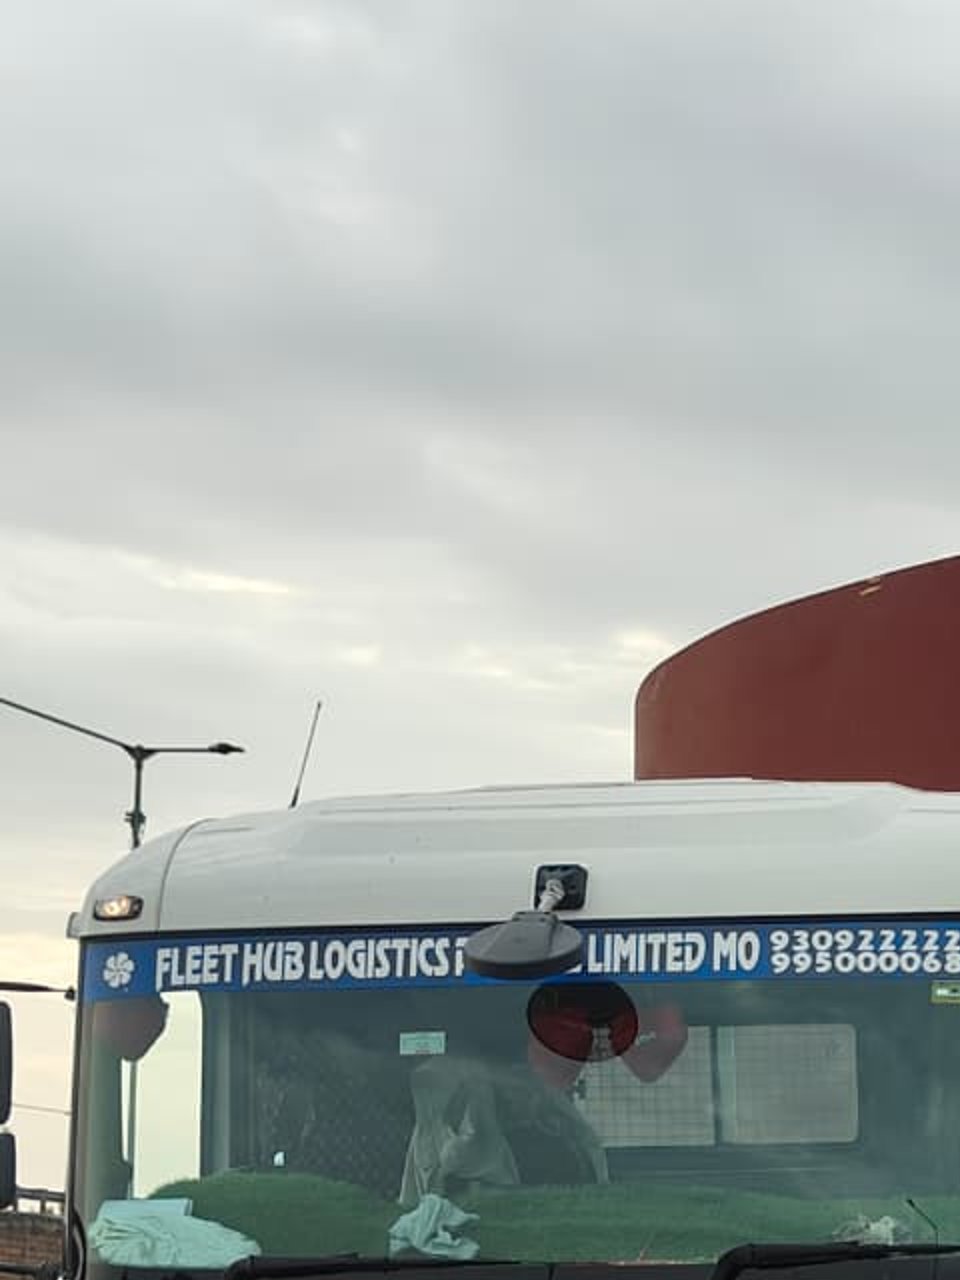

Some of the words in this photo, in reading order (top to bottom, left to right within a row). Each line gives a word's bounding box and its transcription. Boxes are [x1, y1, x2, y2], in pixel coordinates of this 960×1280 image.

[155, 942, 239, 992] FLEET
[242, 942, 305, 986] HUB
[308, 937, 450, 980] LOGISTICS
[586, 933, 706, 974] LIMITED
[712, 931, 760, 972] MO
